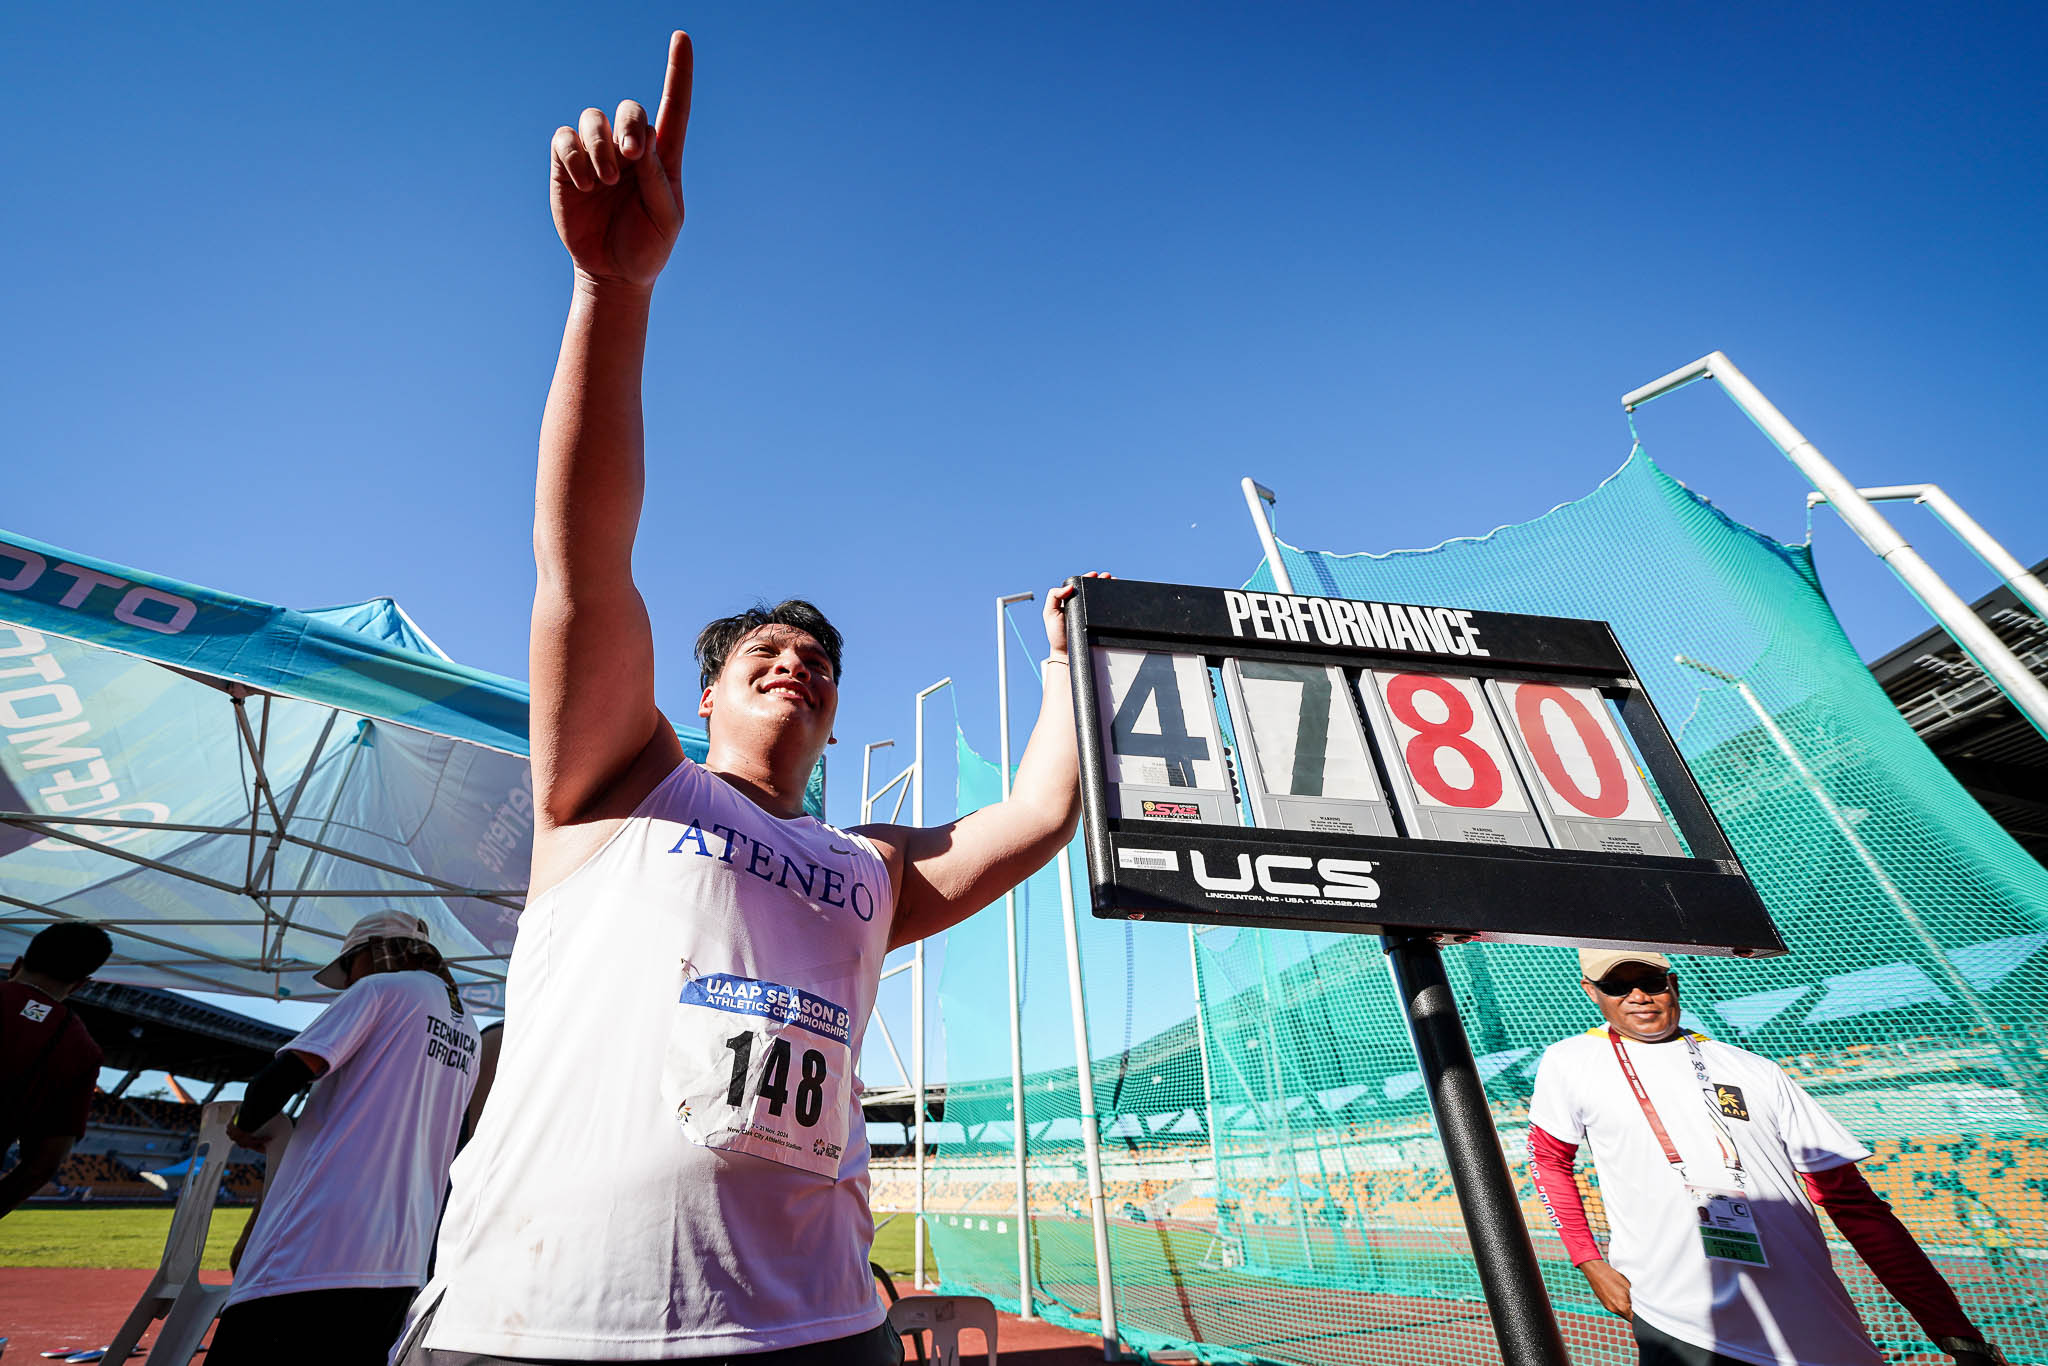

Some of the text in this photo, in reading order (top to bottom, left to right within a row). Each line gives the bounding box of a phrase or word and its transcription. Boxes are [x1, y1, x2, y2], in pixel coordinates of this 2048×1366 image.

[1223, 590, 1490, 658] PERFORMANCE
[668, 818, 874, 922] ATENEO
[1189, 850, 1381, 901] UCS
[706, 978, 762, 1000] UAAP
[765, 989, 834, 1023] SEASON
[706, 995, 850, 1040] ATHLETICS CHAMPIONSHIPS
[725, 1030, 827, 1129] 148
[727, 1126, 740, 1134] New
[754, 1132, 765, 1140] City
[1723, 1106, 1748, 1117] AAP
